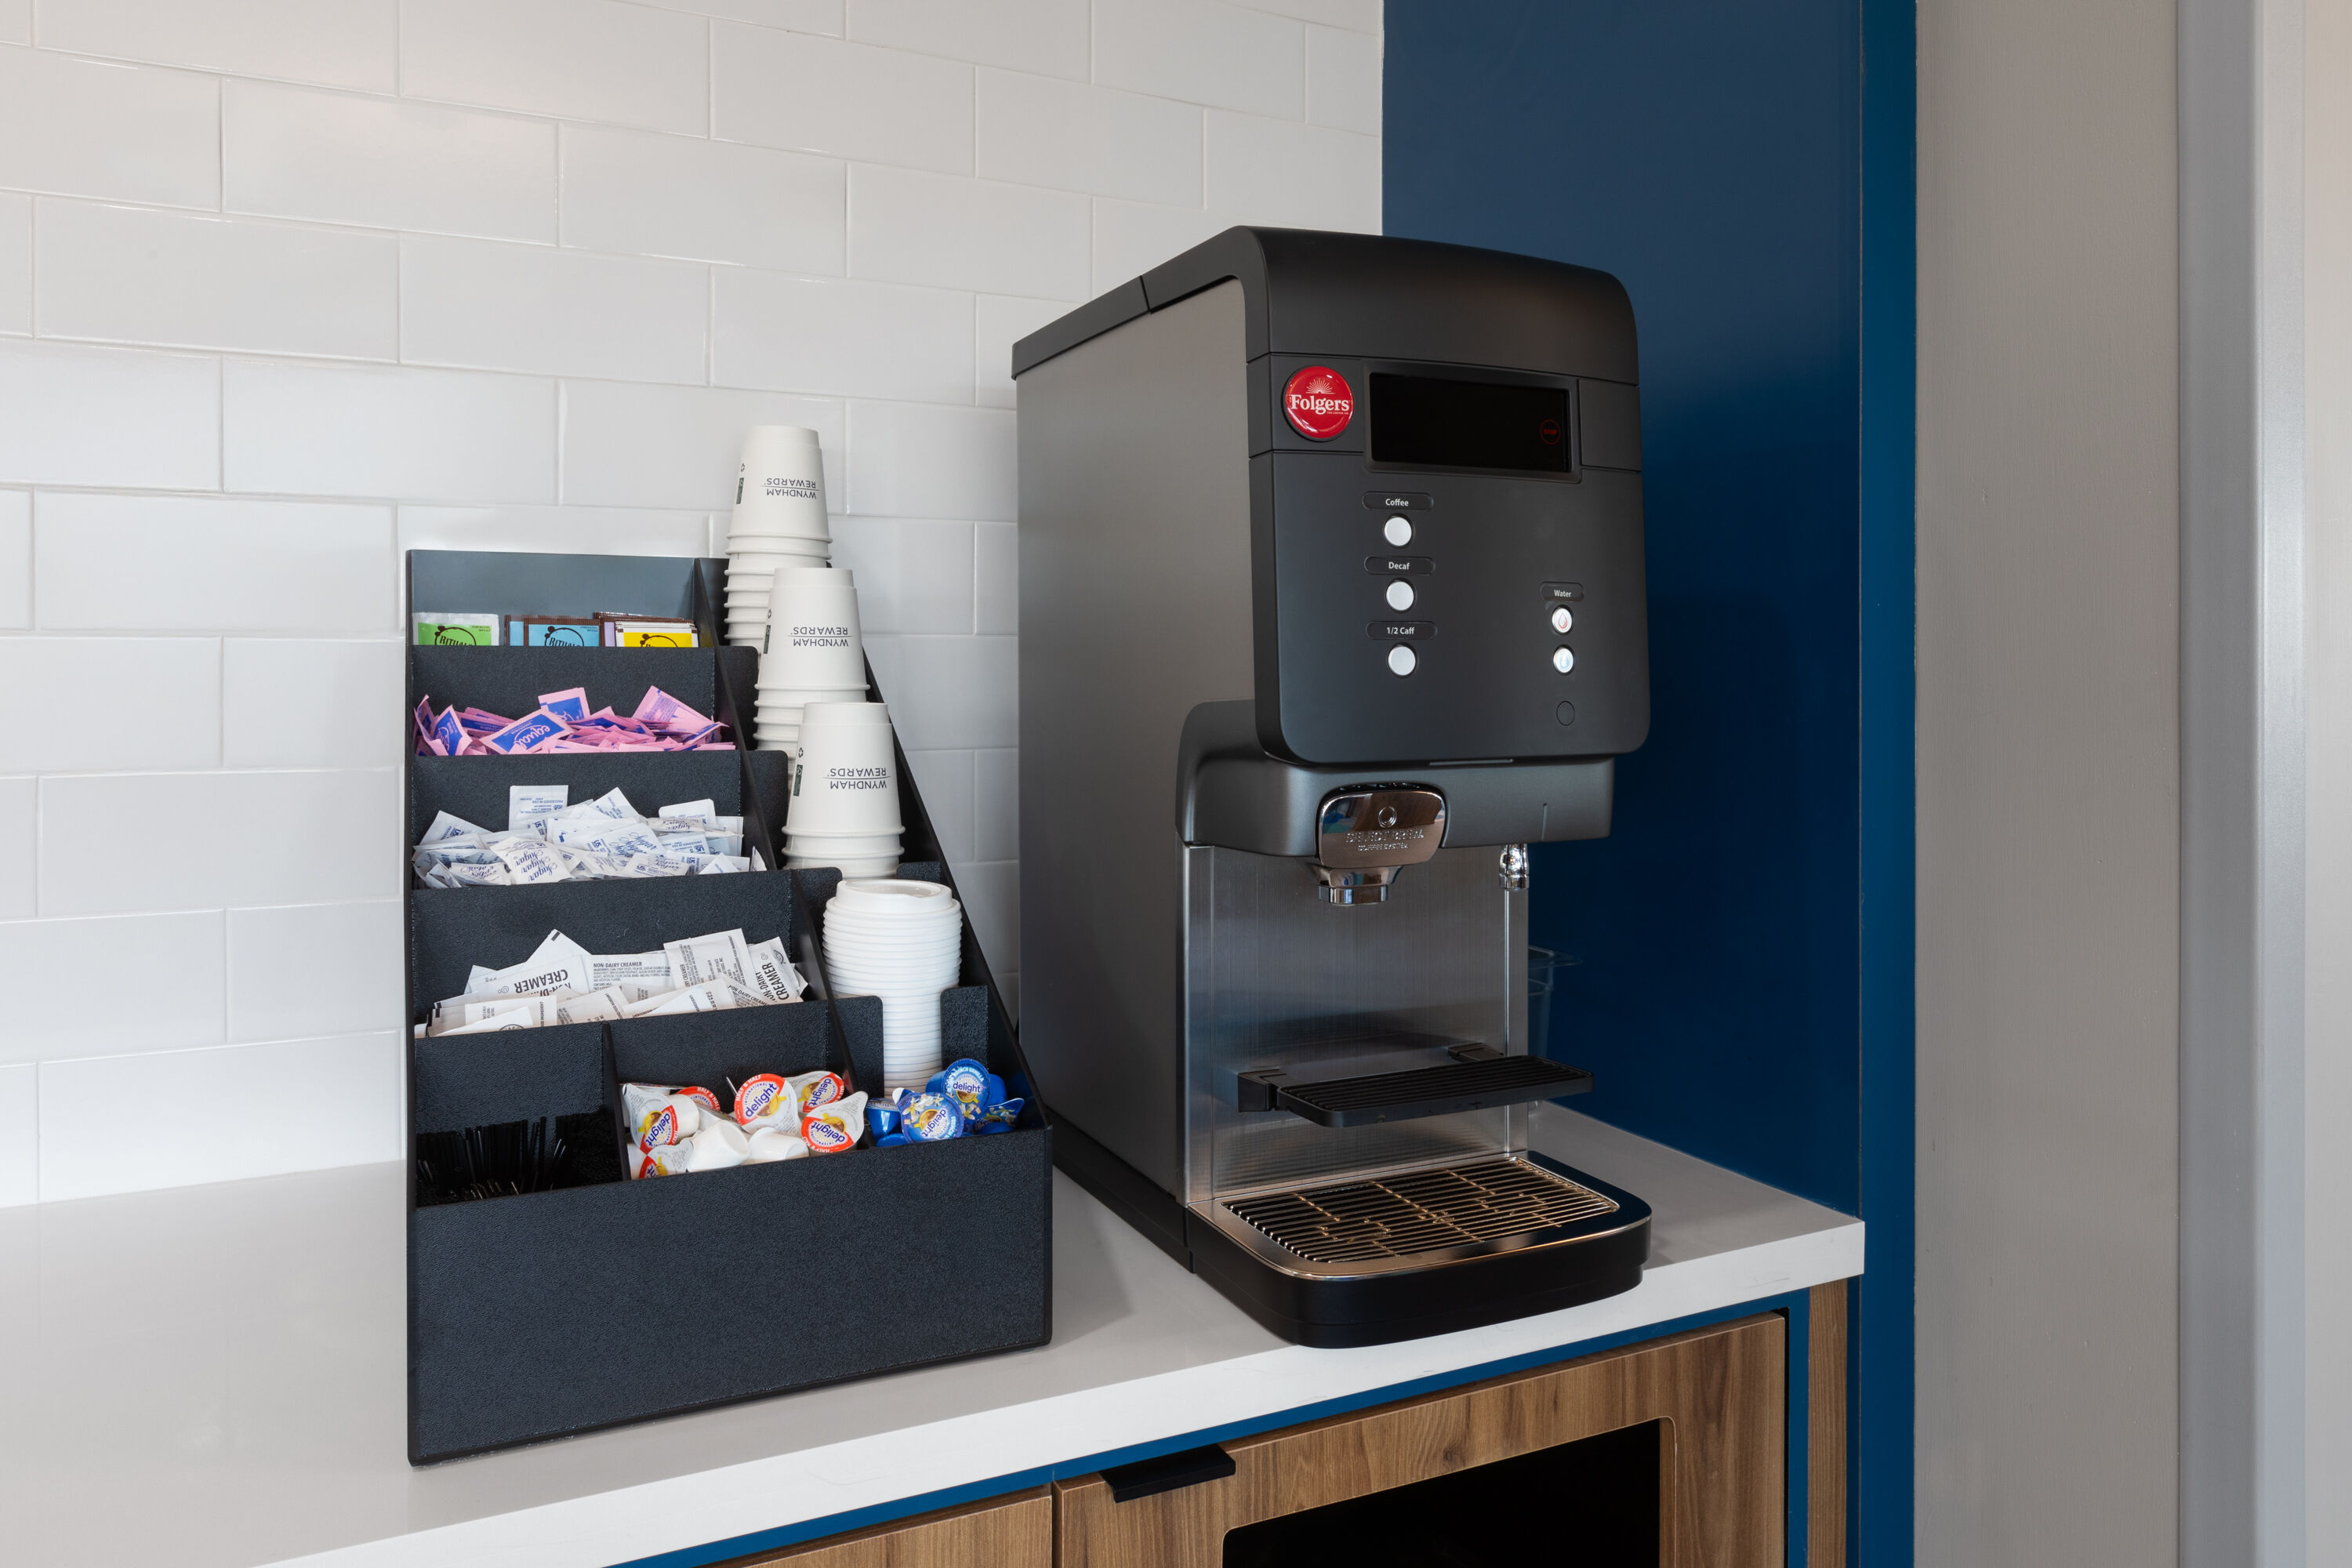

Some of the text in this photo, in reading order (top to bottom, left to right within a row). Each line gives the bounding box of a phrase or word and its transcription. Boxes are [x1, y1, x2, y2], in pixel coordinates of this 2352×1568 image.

[1290, 394, 1350, 415] Folgers
[766, 477, 816, 488] REWARDS
[766, 488, 817, 499] WYNDHAM
[1385, 498, 1410, 506] Coffee
[1388, 561, 1410, 570] Decaf
[1554, 589, 1572, 597] Water
[793, 626, 848, 635] REWARDS
[1386, 626, 1415, 635] 1/2 Caff
[793, 638, 849, 647] WYNDHAM
[829, 768, 887, 777] REWARDS
[829, 780, 887, 789] WYNDHAM
[516, 849, 544, 866] Sugar
[521, 856, 550, 873] Sugar
[528, 862, 558, 881] Sugar
[514, 969, 568, 993] CREAMER
[762, 962, 789, 1000] CREAMER
[735, 1086, 744, 1102] HALF
[747, 1074, 762, 1084] HALF
[808, 1078, 832, 1106] delight
[953, 1082, 981, 1093] delight
[697, 1086, 710, 1096] HALF
[712, 1097, 721, 1111] HALF
[745, 1083, 777, 1117] delight
[645, 1112, 670, 1147] delight
[922, 1109, 946, 1137] delight
[810, 1121, 846, 1143] delight
